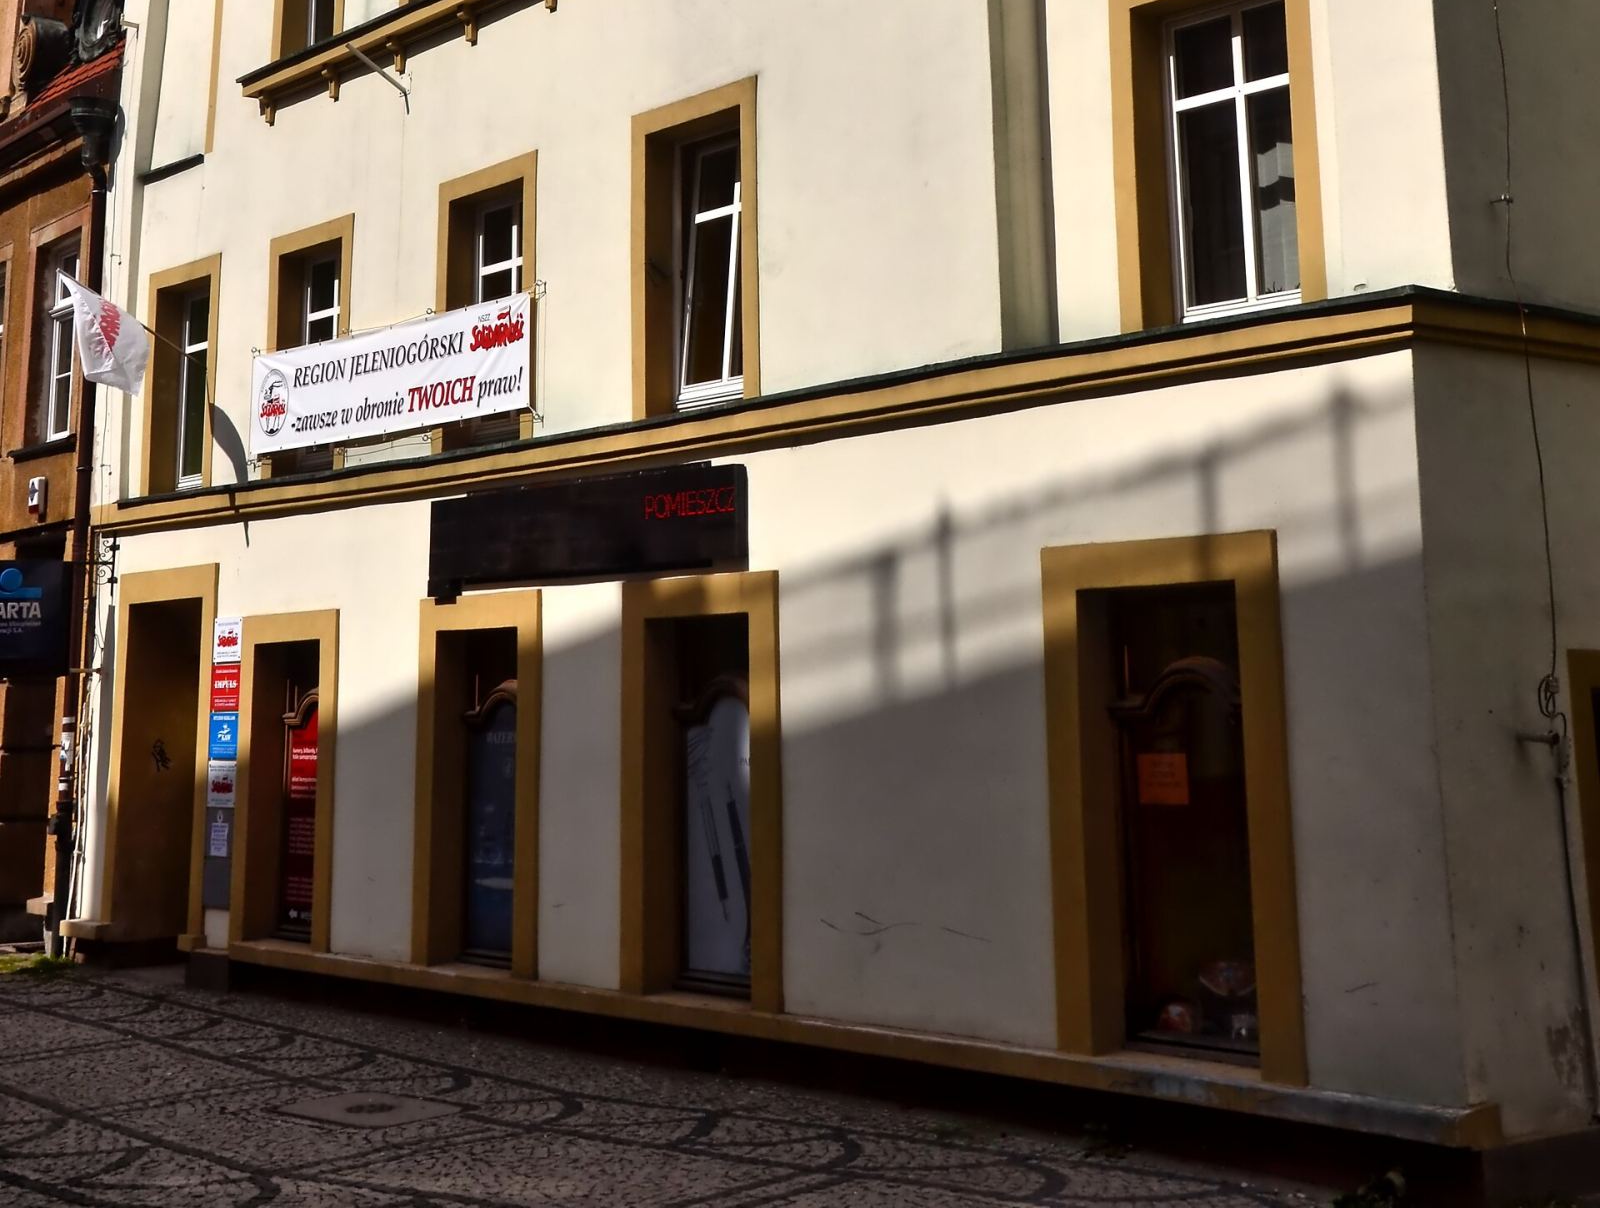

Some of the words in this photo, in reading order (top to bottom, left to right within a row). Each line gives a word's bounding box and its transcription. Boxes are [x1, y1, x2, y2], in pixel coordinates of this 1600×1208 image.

[293, 358, 347, 388] REGION
[349, 331, 464, 382] JELENIOGÓRSKI
[341, 407, 353, 424] w
[355, 392, 404, 422] obronie
[408, 375, 476, 413] TWOICH
[477, 366, 523, 408] praw!
[644, 486, 736, 520] POMIESZCZ
